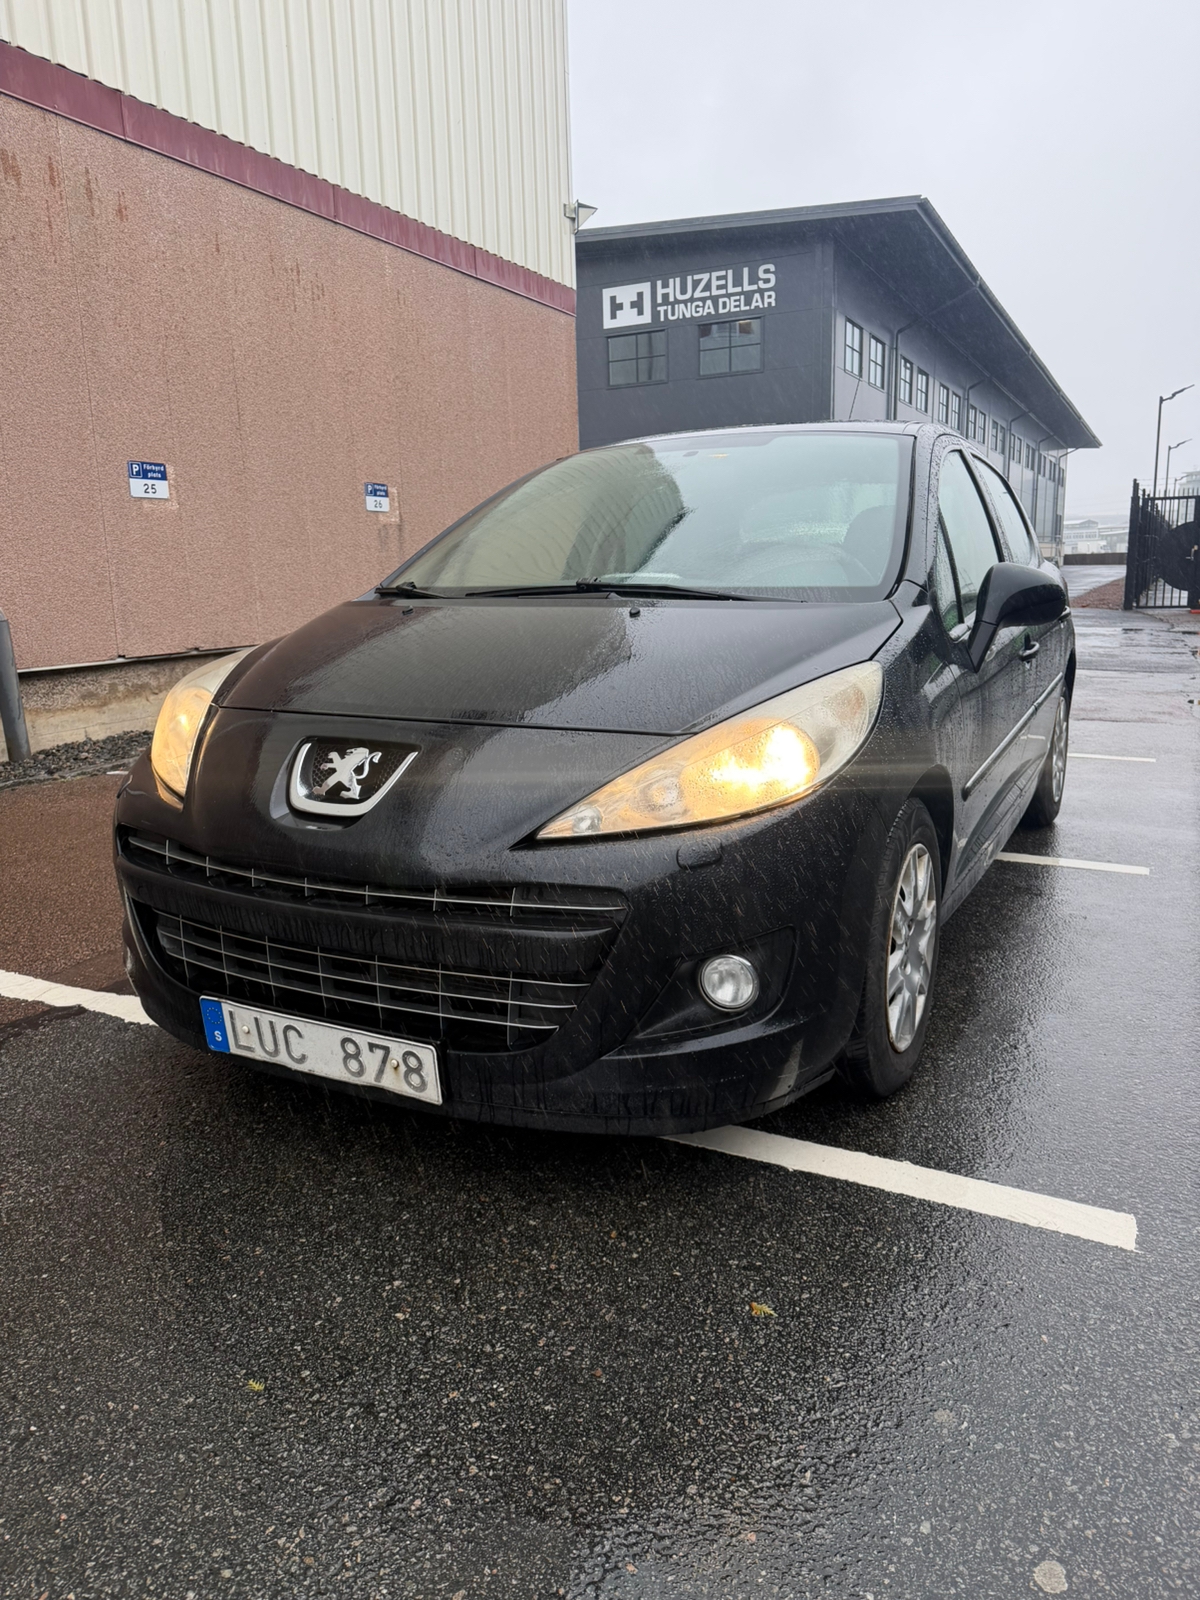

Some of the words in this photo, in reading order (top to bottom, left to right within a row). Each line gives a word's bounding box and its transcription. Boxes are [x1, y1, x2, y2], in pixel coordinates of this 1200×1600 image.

[656, 263, 776, 304] HUZELLS
[657, 301, 715, 322] TUNGA
[718, 290, 776, 313] DELAR
[132, 464, 139, 475] P
[143, 483, 157, 494] 25
[374, 499, 383, 509] 26
[214, 1030, 223, 1042] S
[228, 1009, 308, 1065] LUC
[340, 1036, 428, 1093] 878
